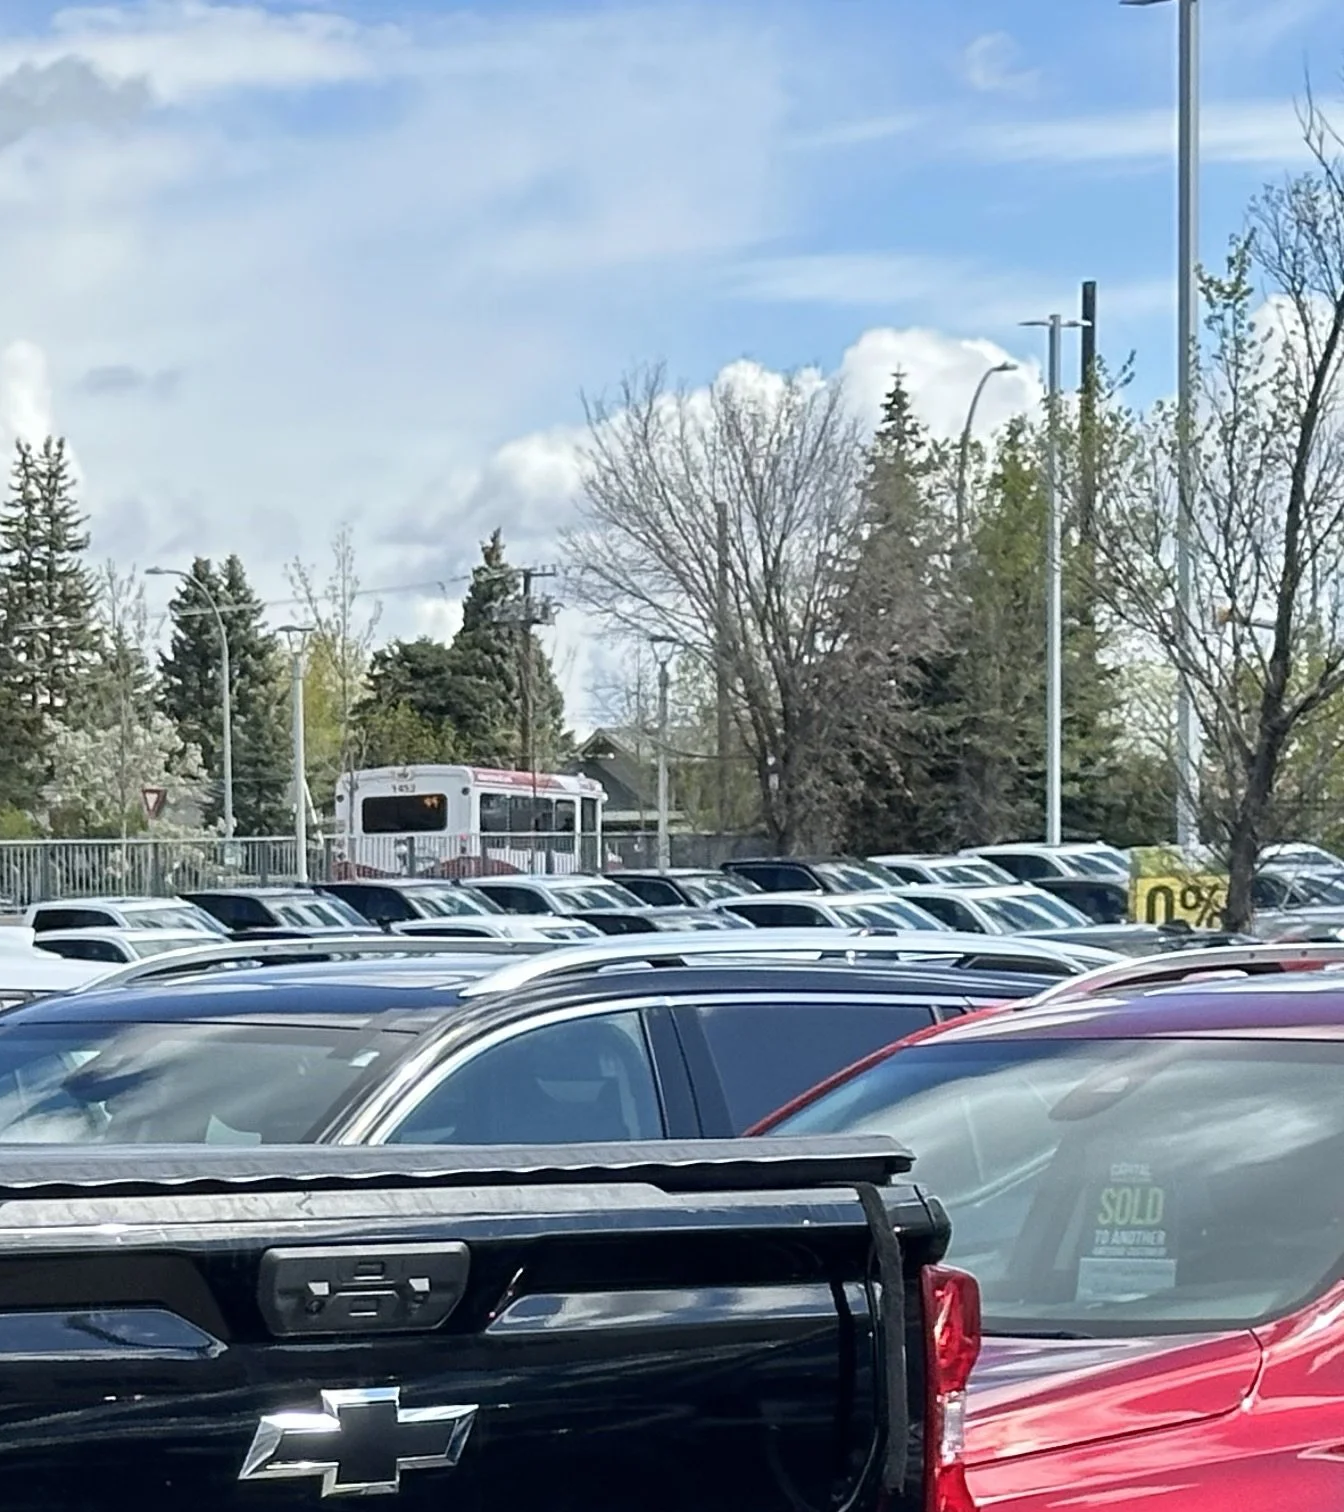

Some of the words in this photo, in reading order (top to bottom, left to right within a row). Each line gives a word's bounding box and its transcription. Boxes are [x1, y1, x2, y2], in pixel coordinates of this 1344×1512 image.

[1097, 1187, 1165, 1226] SOLD
[1095, 1229, 1110, 1245] TO
[1111, 1229, 1167, 1246] ANOTHER
